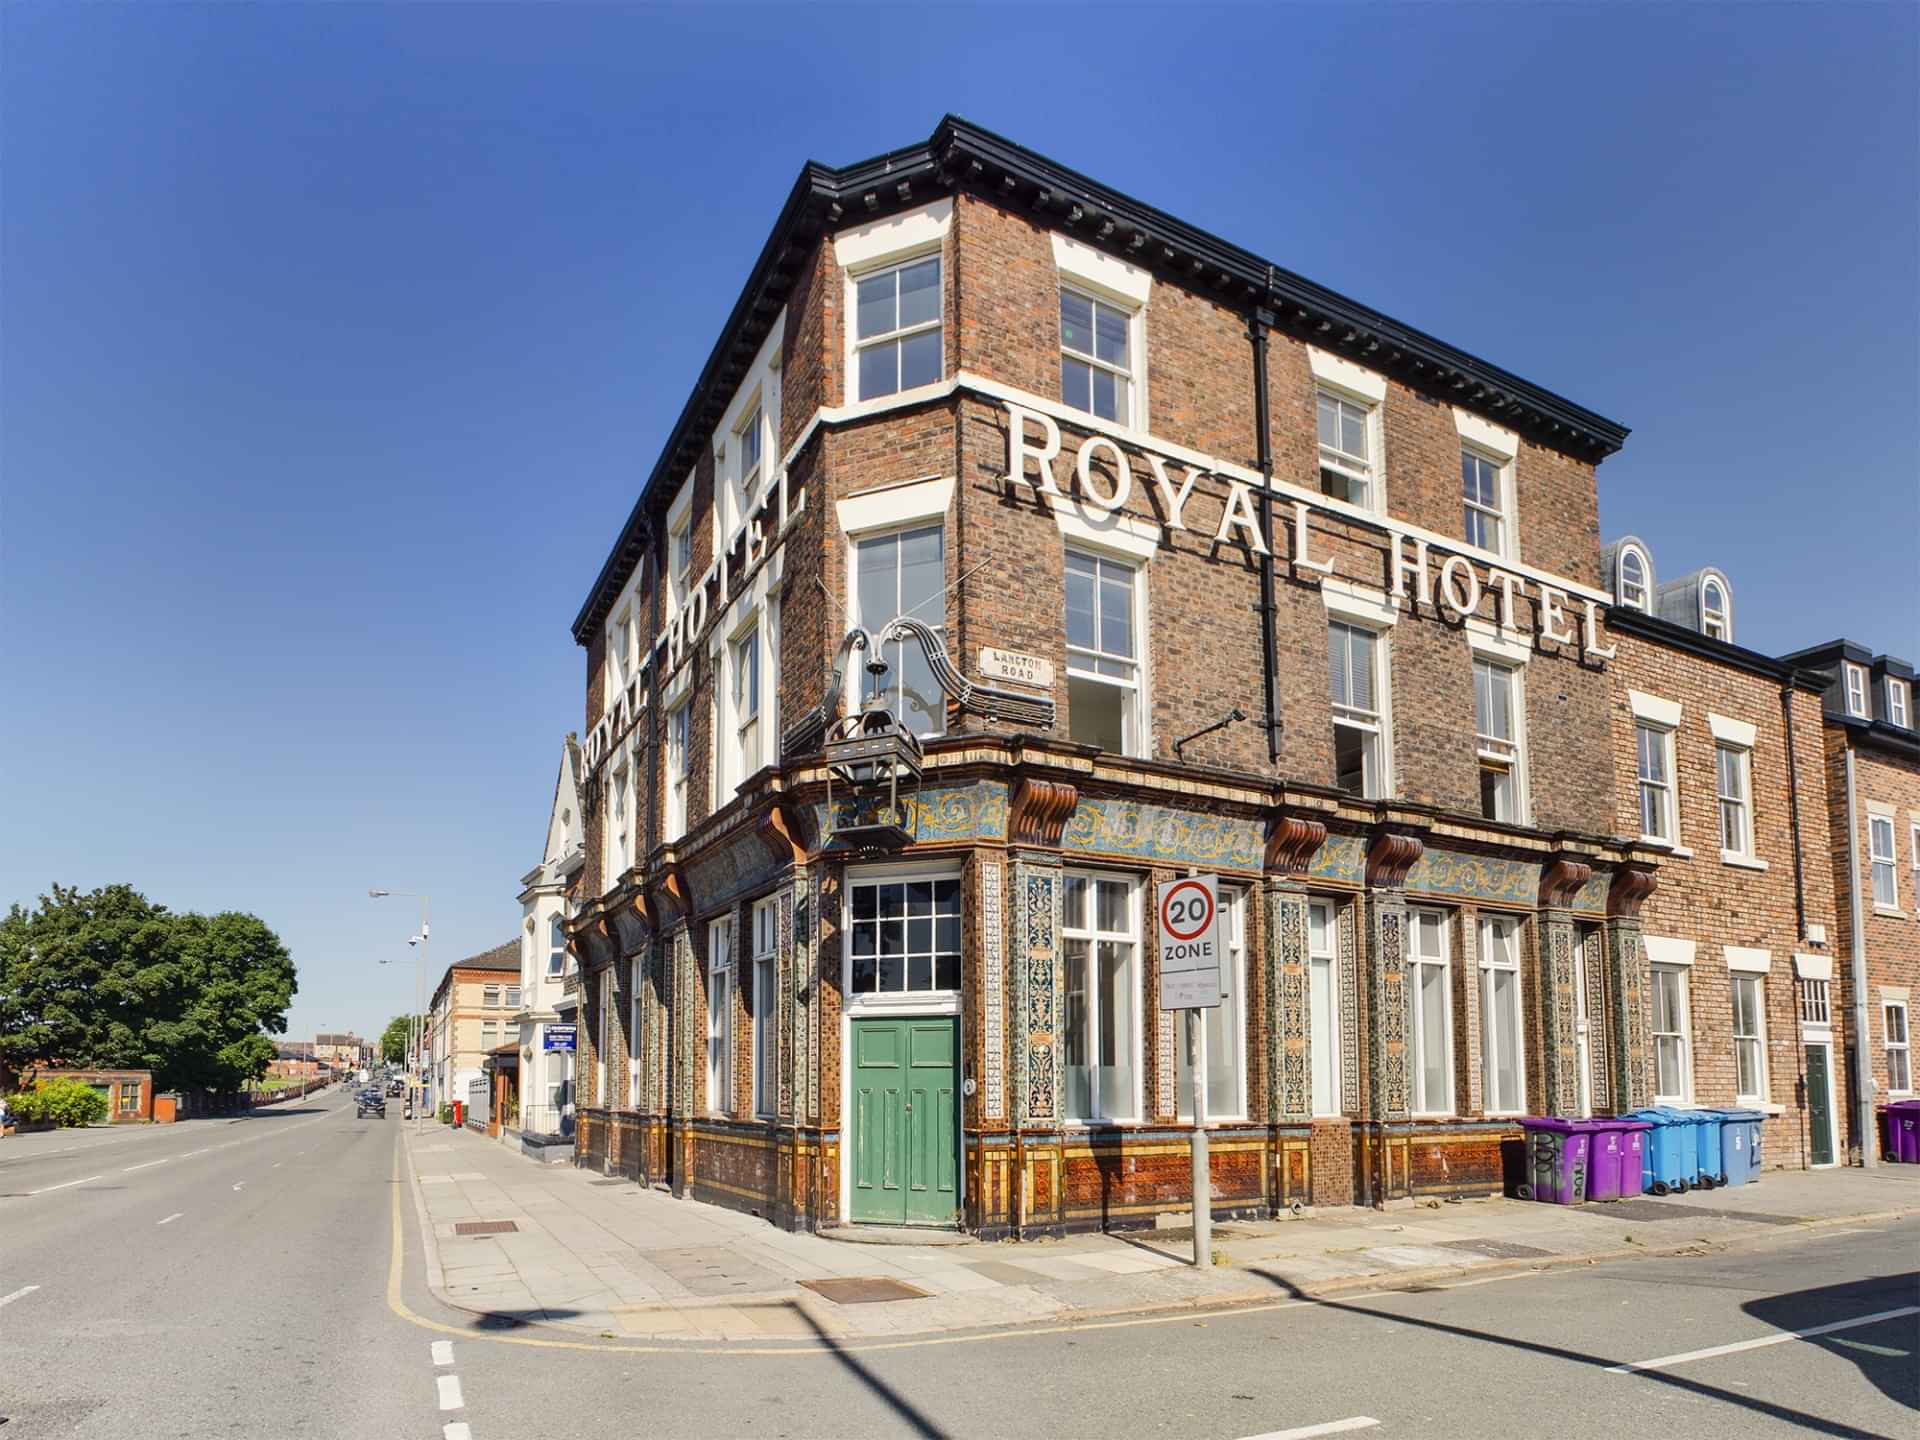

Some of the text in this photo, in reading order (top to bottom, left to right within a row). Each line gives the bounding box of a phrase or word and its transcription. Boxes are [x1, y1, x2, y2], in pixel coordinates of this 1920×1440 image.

[1003, 402, 1617, 659] ROYAL HOTEL
[581, 471, 805, 784] ROYAL HOTEL
[1001, 665, 1033, 680] ROAD
[1170, 897, 1206, 923] 20
[1165, 942, 1212, 960] ZONE
